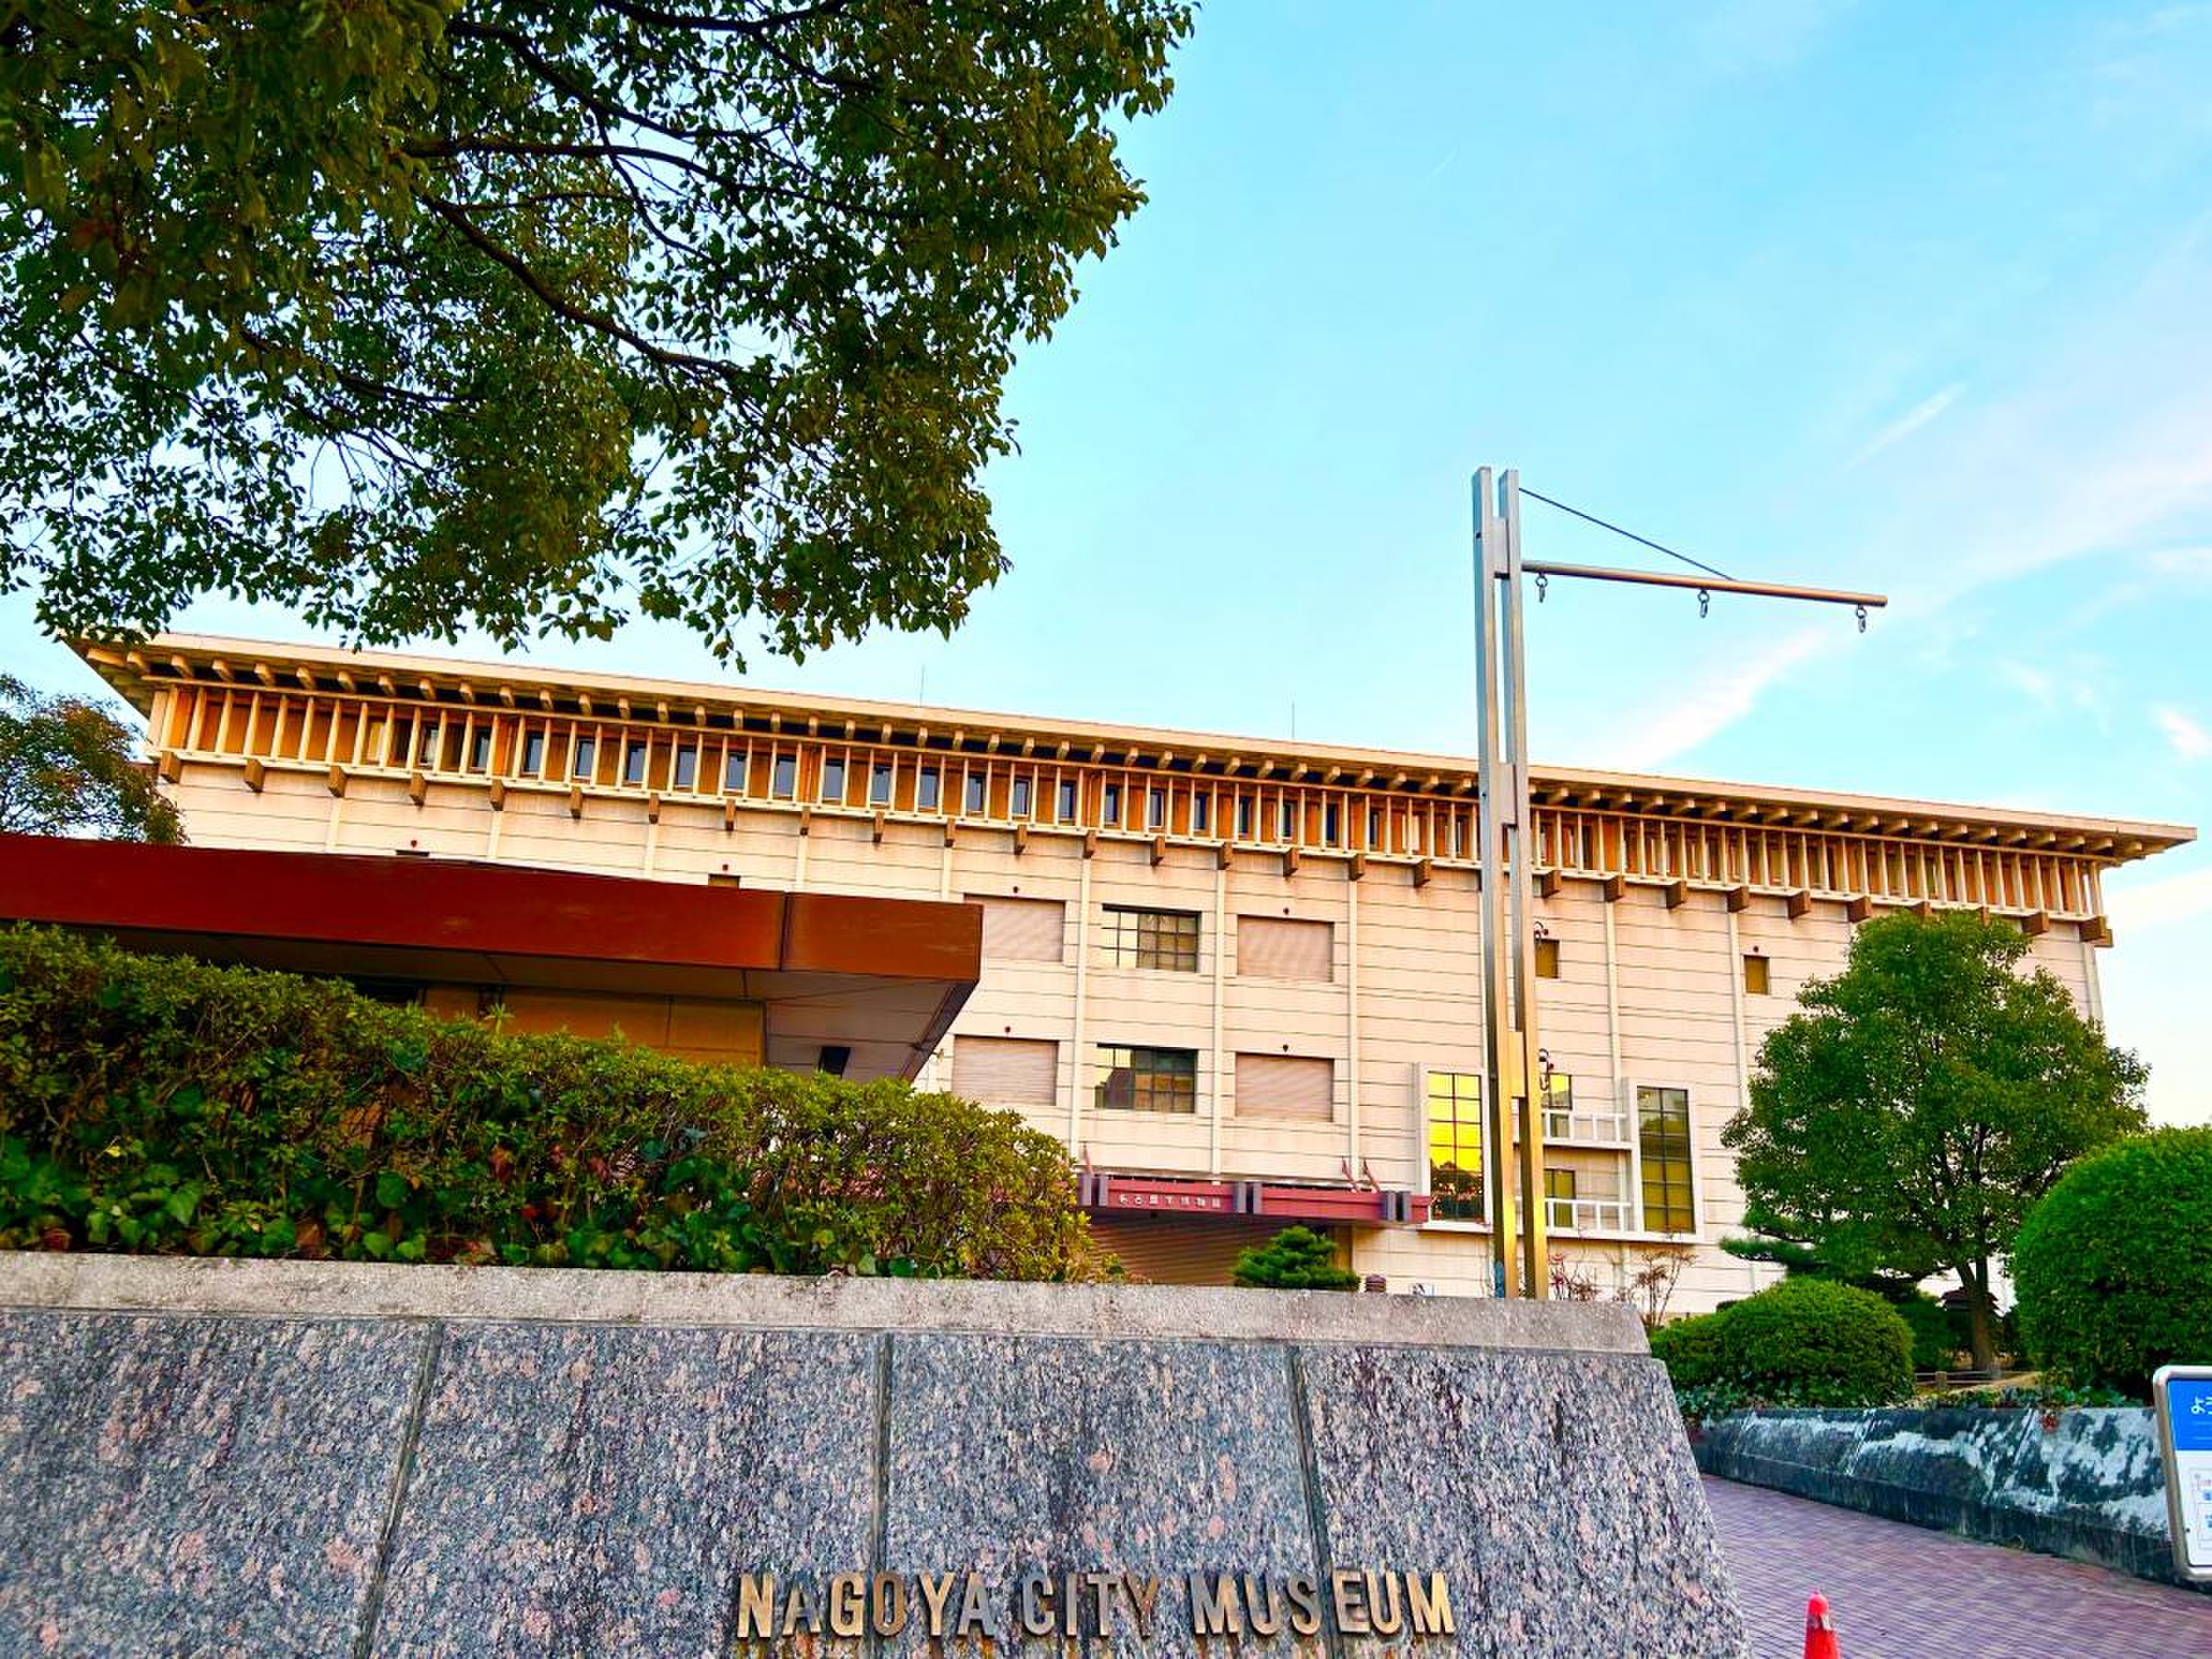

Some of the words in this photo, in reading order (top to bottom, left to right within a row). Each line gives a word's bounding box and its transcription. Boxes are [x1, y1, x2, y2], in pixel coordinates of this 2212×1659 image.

[736, 1571, 996, 1638] NAGOYA
[1021, 1571, 1159, 1639] CITY
[1188, 1570, 1455, 1636] MUSEUM
